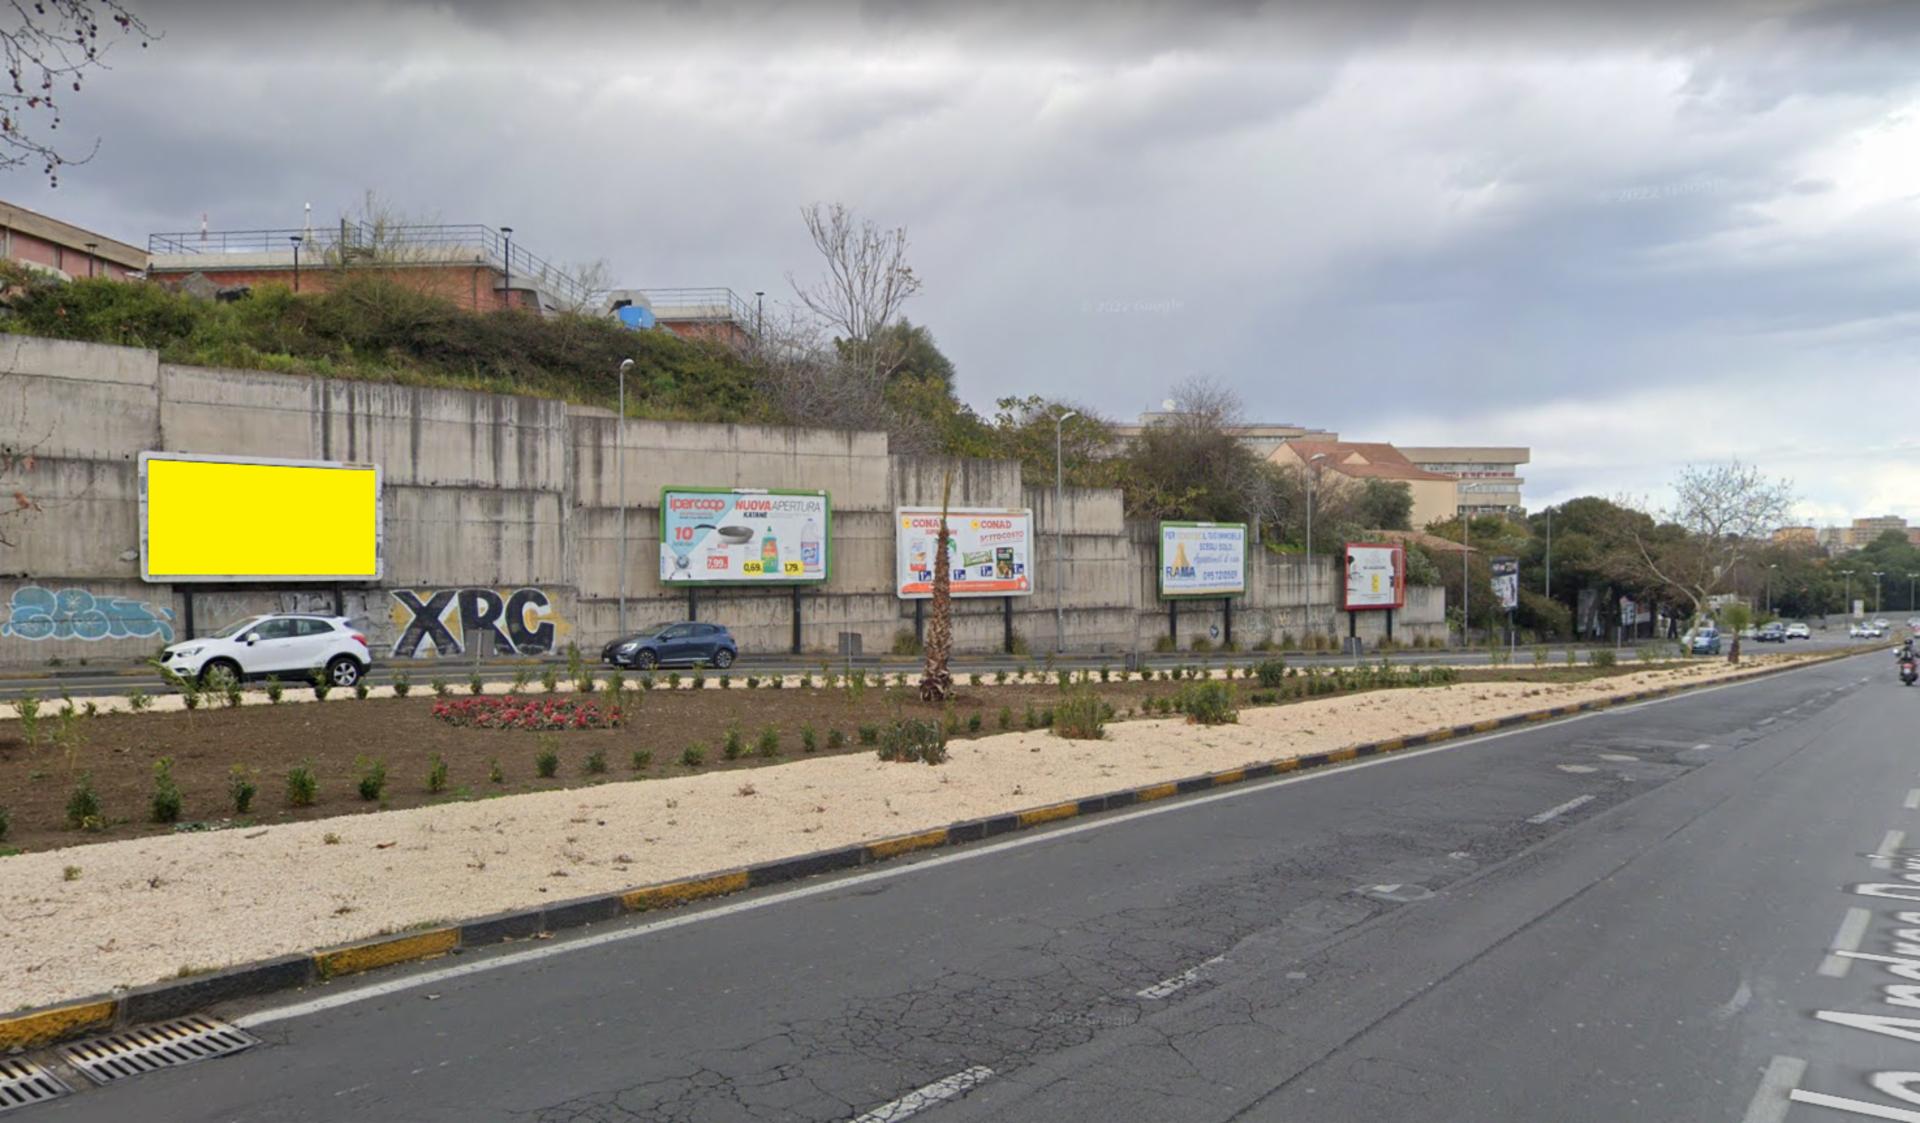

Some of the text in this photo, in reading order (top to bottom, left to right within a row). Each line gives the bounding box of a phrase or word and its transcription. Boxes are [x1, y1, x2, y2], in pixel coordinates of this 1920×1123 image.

[670, 495, 725, 511] ipercoop
[736, 500, 821, 512] NUOVA APERTURA
[912, 519, 940, 528] CONA
[980, 520, 1012, 529] CONAD
[674, 527, 693, 541] 10
